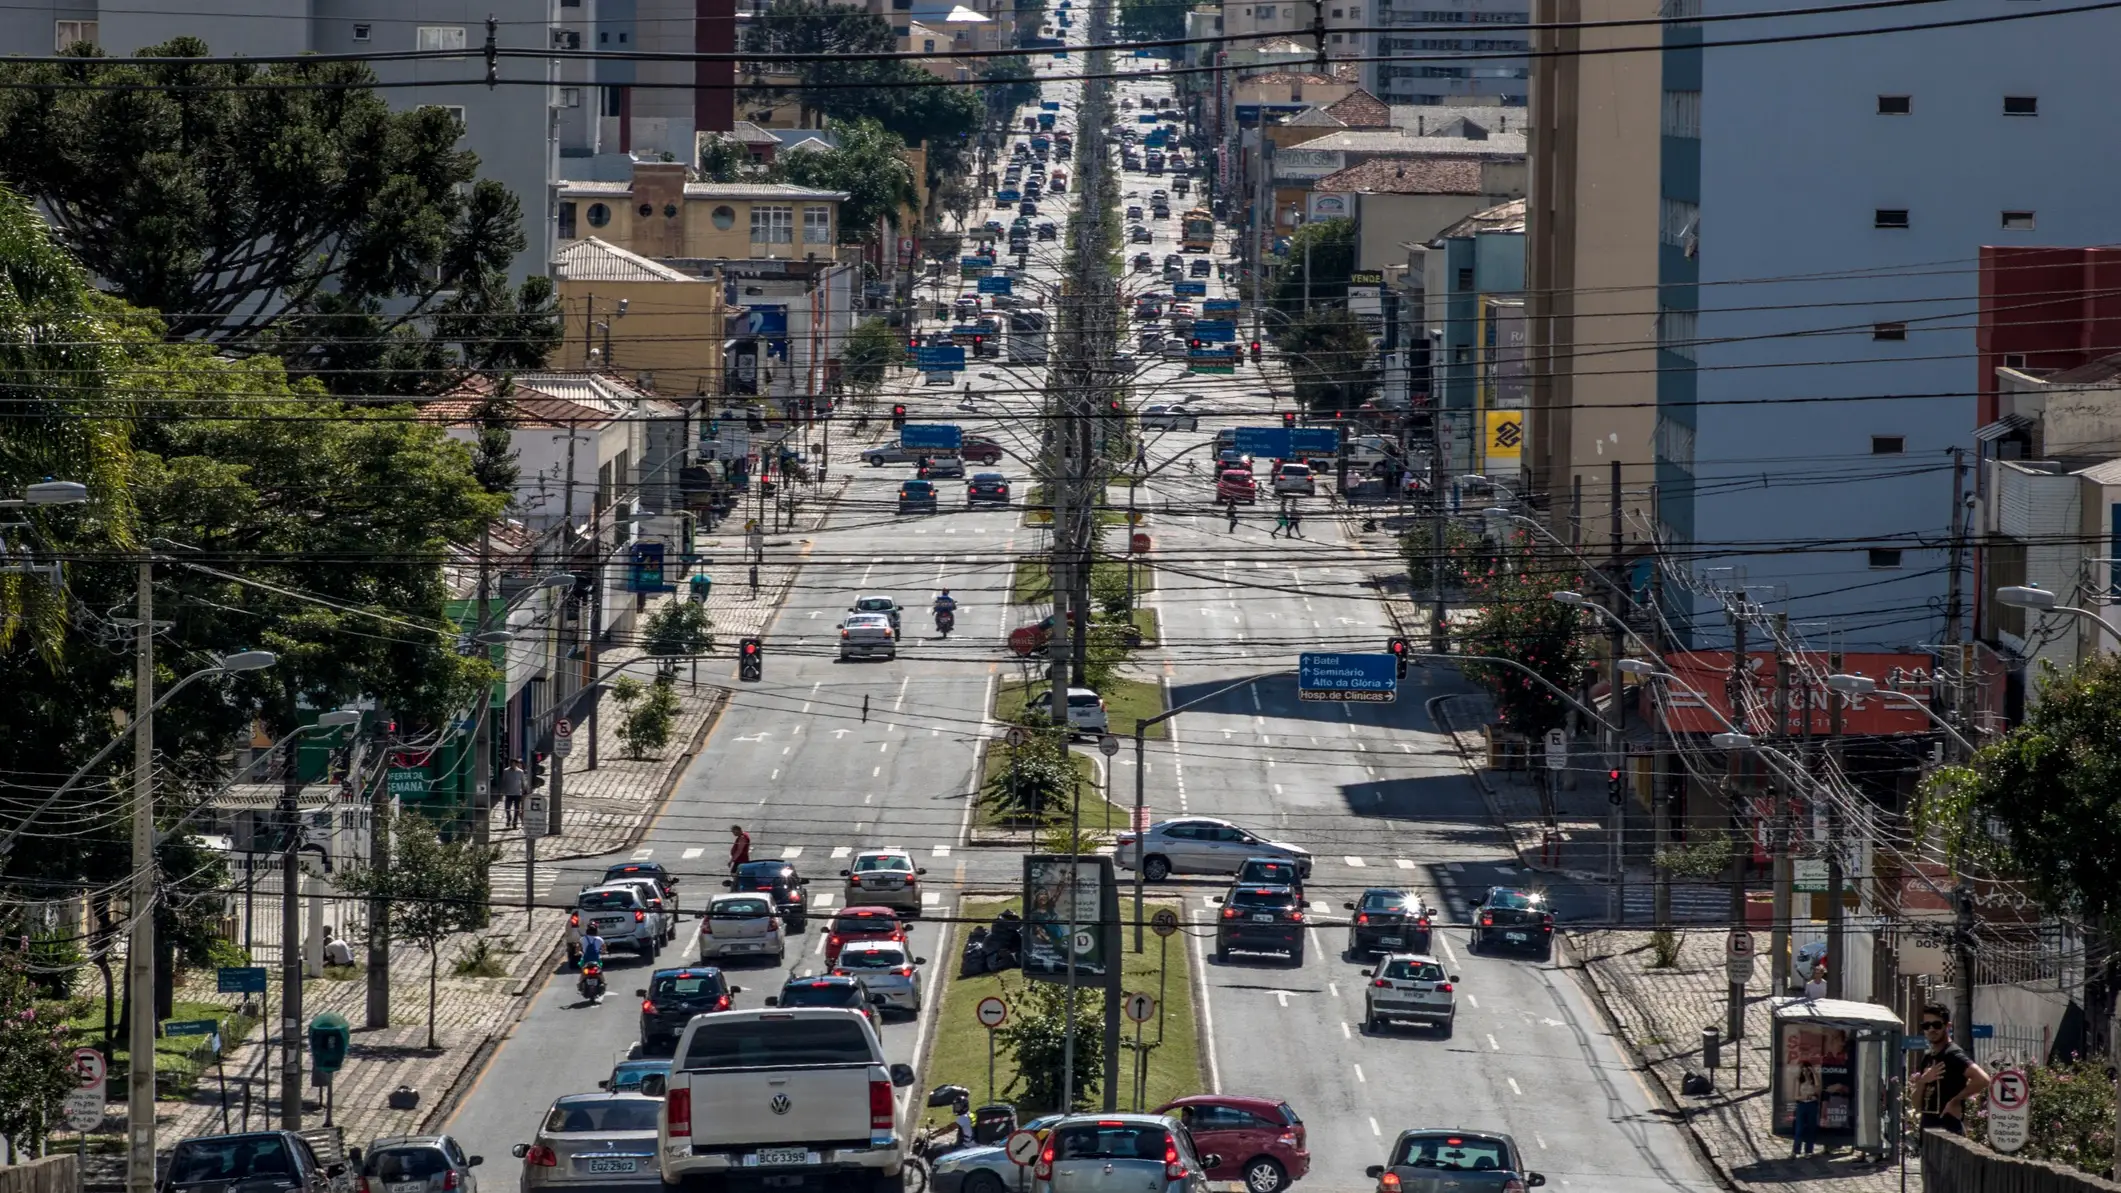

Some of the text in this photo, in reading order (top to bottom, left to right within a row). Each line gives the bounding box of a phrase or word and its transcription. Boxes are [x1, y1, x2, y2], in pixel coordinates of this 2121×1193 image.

[1351, 274, 1381, 283] VENDE
[1313, 656, 1340, 665] Batel
[1313, 668, 1365, 677] Seminário
[1313, 678, 1381, 688] Alto da Glória
[1915, 940, 1940, 949] DOS
